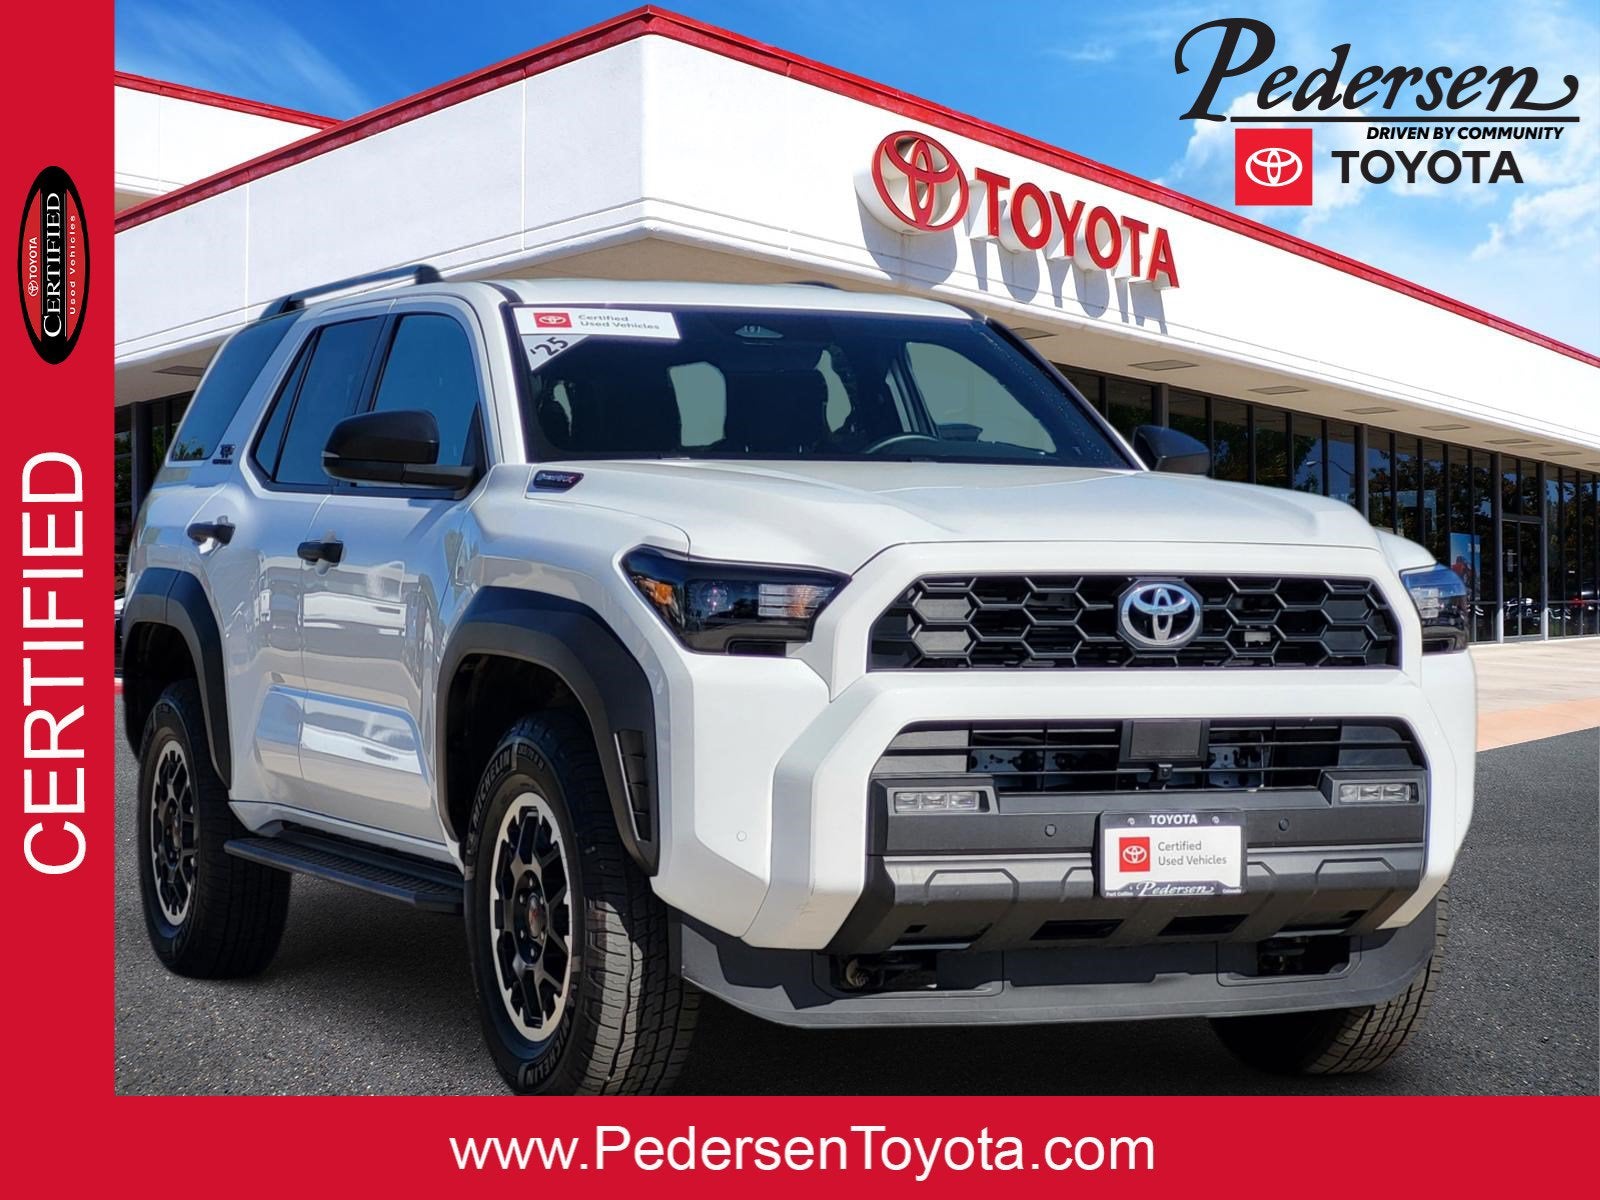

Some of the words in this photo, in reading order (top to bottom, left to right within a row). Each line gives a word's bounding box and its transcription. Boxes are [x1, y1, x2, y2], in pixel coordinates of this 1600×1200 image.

[974, 167, 1180, 288] TOYOTA
[578, 314, 629, 322] Certified
[612, 321, 660, 330] Vehicles
[530, 336, 568, 356] '25
[1149, 814, 1198, 825] TOYOTA
[1157, 841, 1202, 852] Certified
[1158, 856, 1184, 866] Used
[1186, 855, 1228, 865] Vehicles
[1136, 881, 1216, 897] Pedersen
